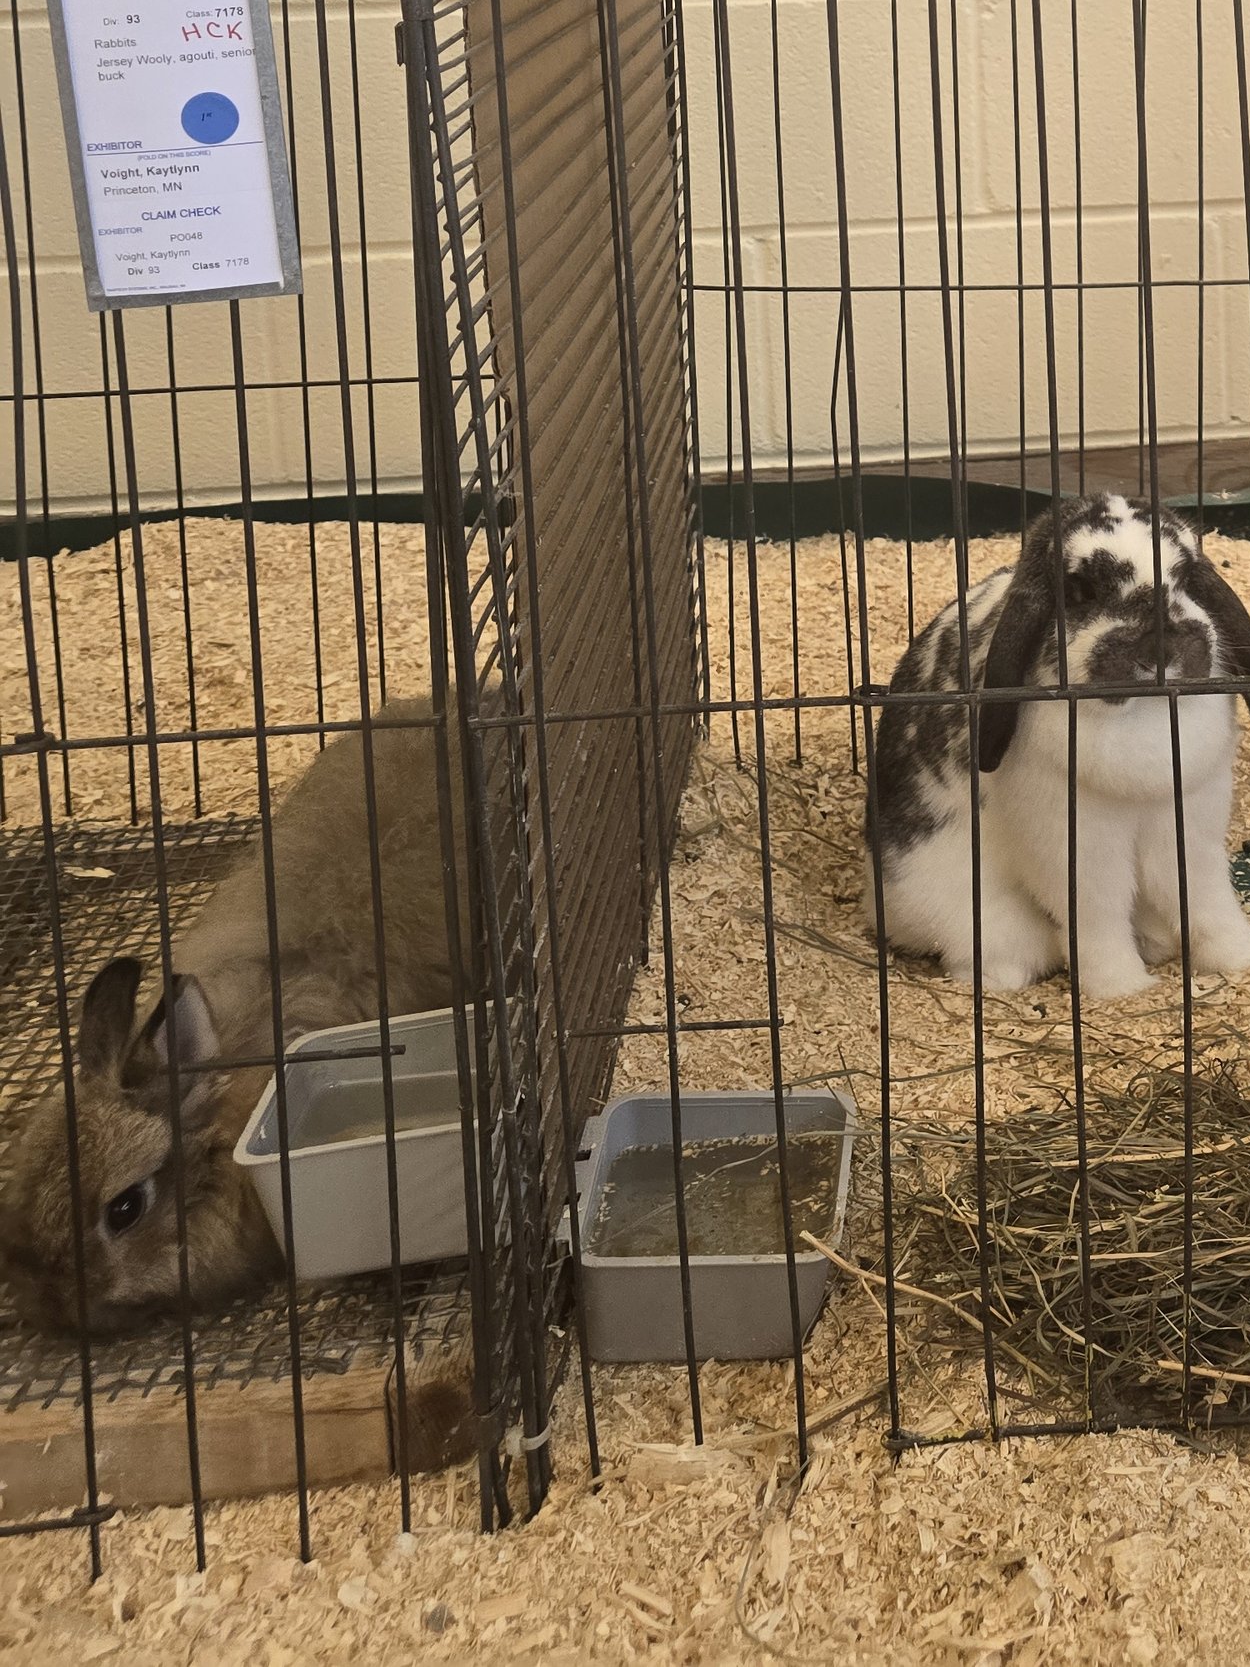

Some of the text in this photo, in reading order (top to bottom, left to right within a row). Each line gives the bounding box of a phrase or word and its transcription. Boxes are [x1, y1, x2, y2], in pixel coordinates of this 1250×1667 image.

[126, 14, 141, 24] 93
[215, 6, 244, 18] 7178
[94, 38, 137, 49] Rabbits
[96, 56, 133, 69] Jersey
[221, 46, 256, 58] senior
[98, 71, 125, 82] buck
[87, 140, 142, 152] EXHIBITOR
[163, 182, 182, 192] MN
[141, 206, 222, 221] CLAIM CHECK
[98, 226, 143, 236] EXHIBITOR
[128, 257, 249, 276] Div 93 Class 7178
